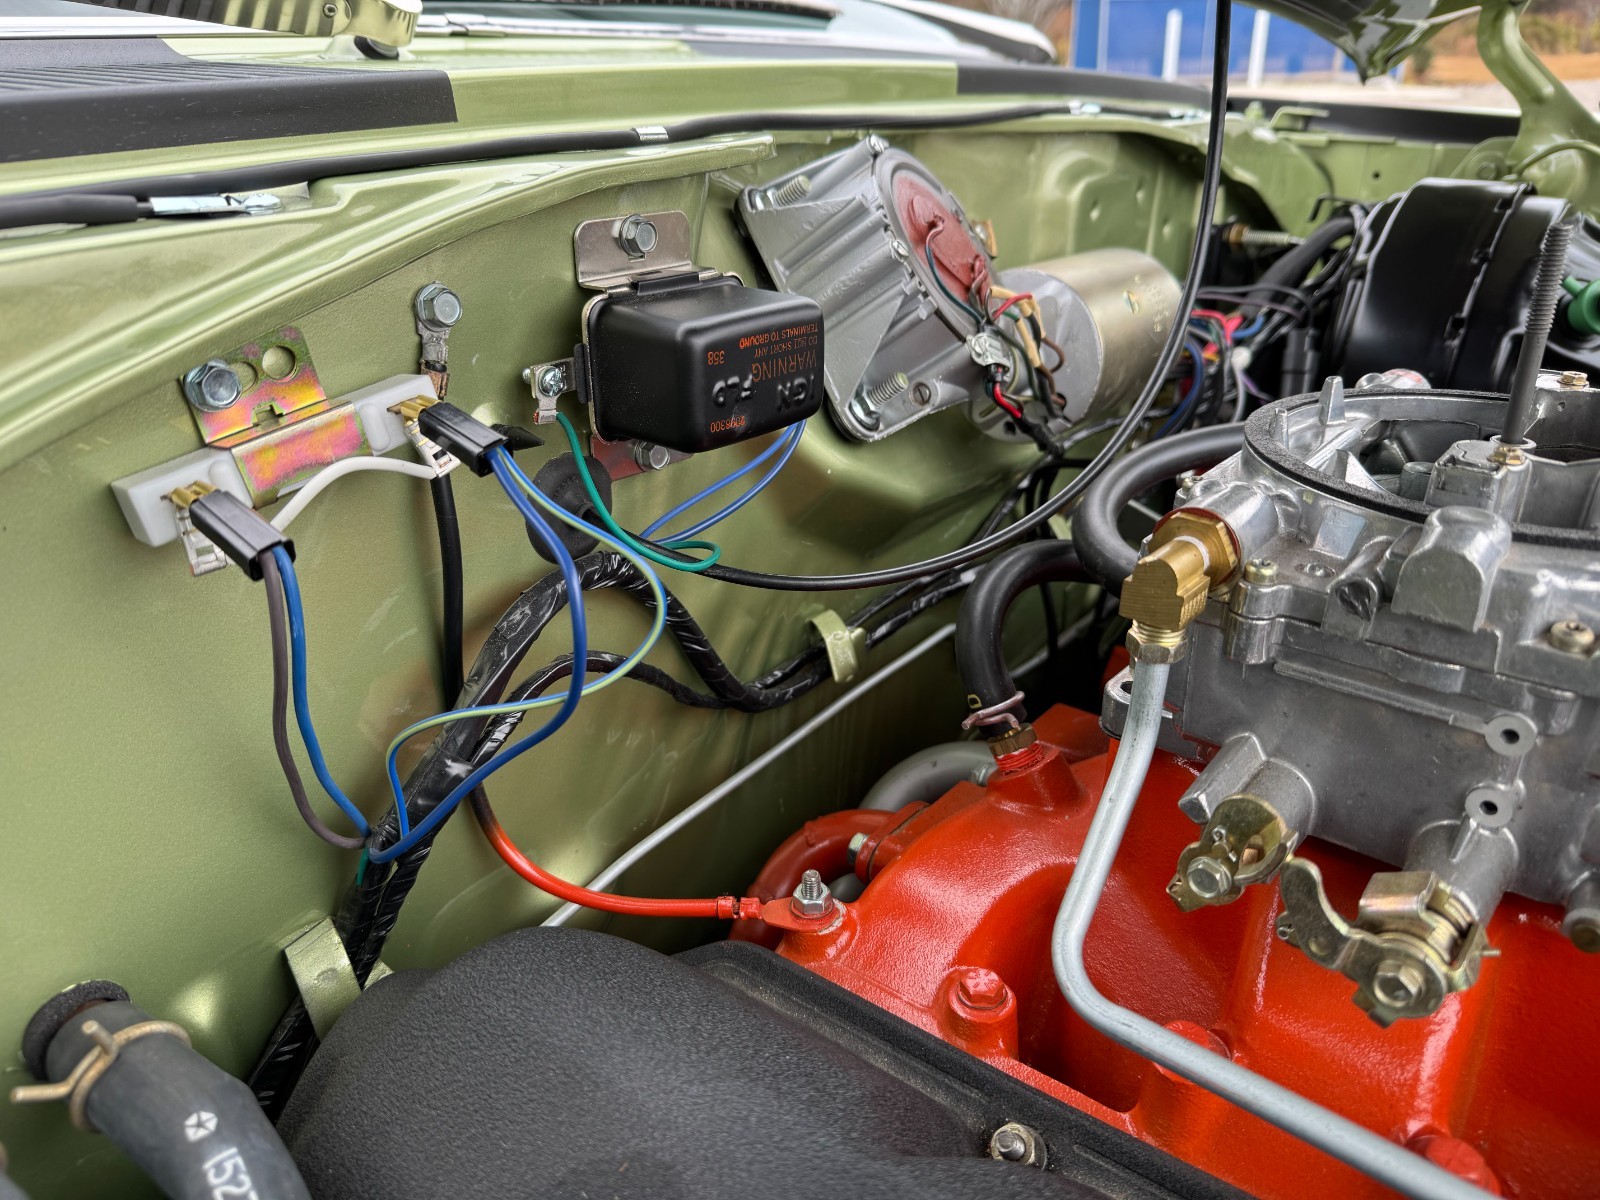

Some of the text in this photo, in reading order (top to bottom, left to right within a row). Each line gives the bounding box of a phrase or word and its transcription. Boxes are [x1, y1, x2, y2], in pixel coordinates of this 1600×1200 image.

[739, 323, 818, 349] TERMINALS TO GROUND
[770, 341, 791, 355] SHORT
[808, 336, 818, 346] DO
[707, 350, 725, 365] 358
[754, 346, 768, 358] ANY
[751, 349, 817, 382] WARNING
[712, 373, 753, 408] FLD
[777, 373, 815, 411] IGN
[203, 1147, 259, 1200] 152
